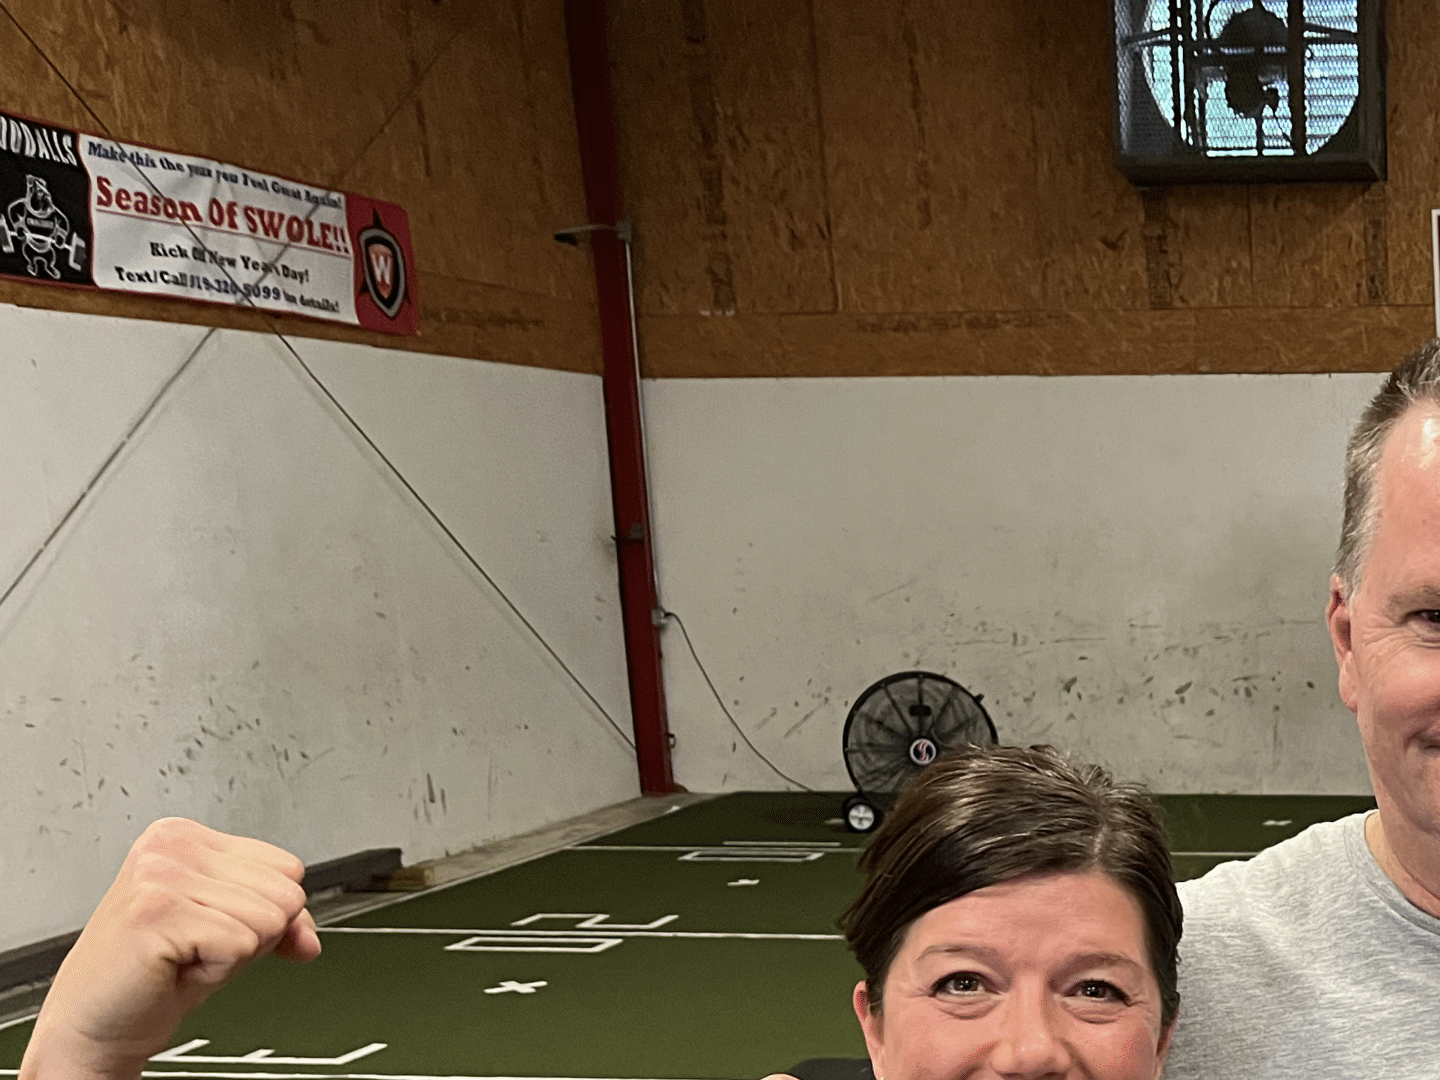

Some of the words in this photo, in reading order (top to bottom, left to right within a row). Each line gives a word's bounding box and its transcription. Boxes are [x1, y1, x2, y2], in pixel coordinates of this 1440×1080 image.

[88, 141, 126, 163] Make
[127, 152, 157, 168] this
[160, 157, 184, 172] the
[97, 175, 203, 222] Season
[209, 197, 238, 230] Of
[243, 205, 349, 254] SWOLE!!
[149, 242, 189, 259] Kick
[281, 264, 309, 284] Day!
[371, 253, 392, 285] W
